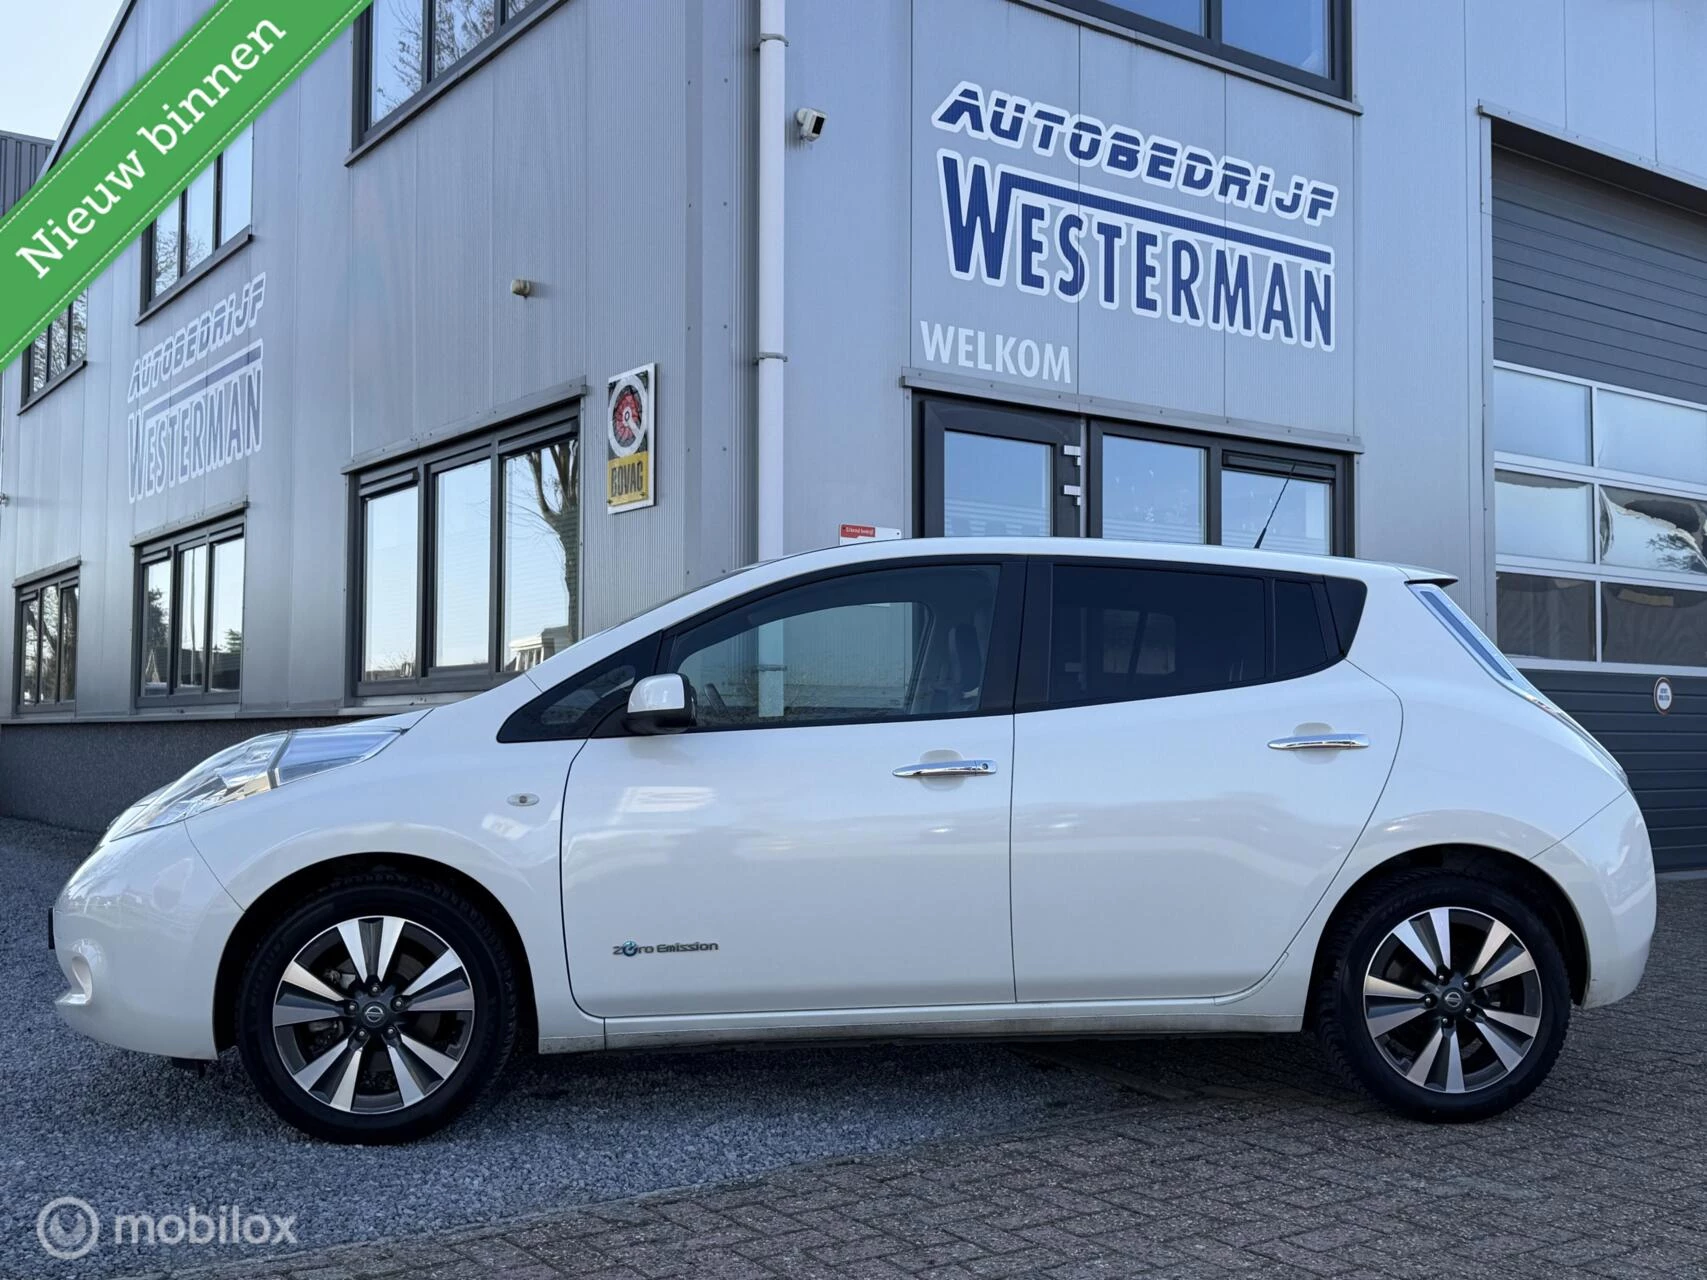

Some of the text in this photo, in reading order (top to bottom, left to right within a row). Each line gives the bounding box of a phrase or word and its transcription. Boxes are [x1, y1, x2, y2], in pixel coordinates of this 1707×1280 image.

[935, 84, 1337, 225] AUTOBEDRIJF
[939, 152, 1334, 349] WESTERMAN
[128, 272, 266, 403] AUTOBEDRIJF
[920, 320, 1072, 385] WELKOM
[128, 350, 264, 504] WESTERMAN
[611, 460, 644, 497] BOVAG
